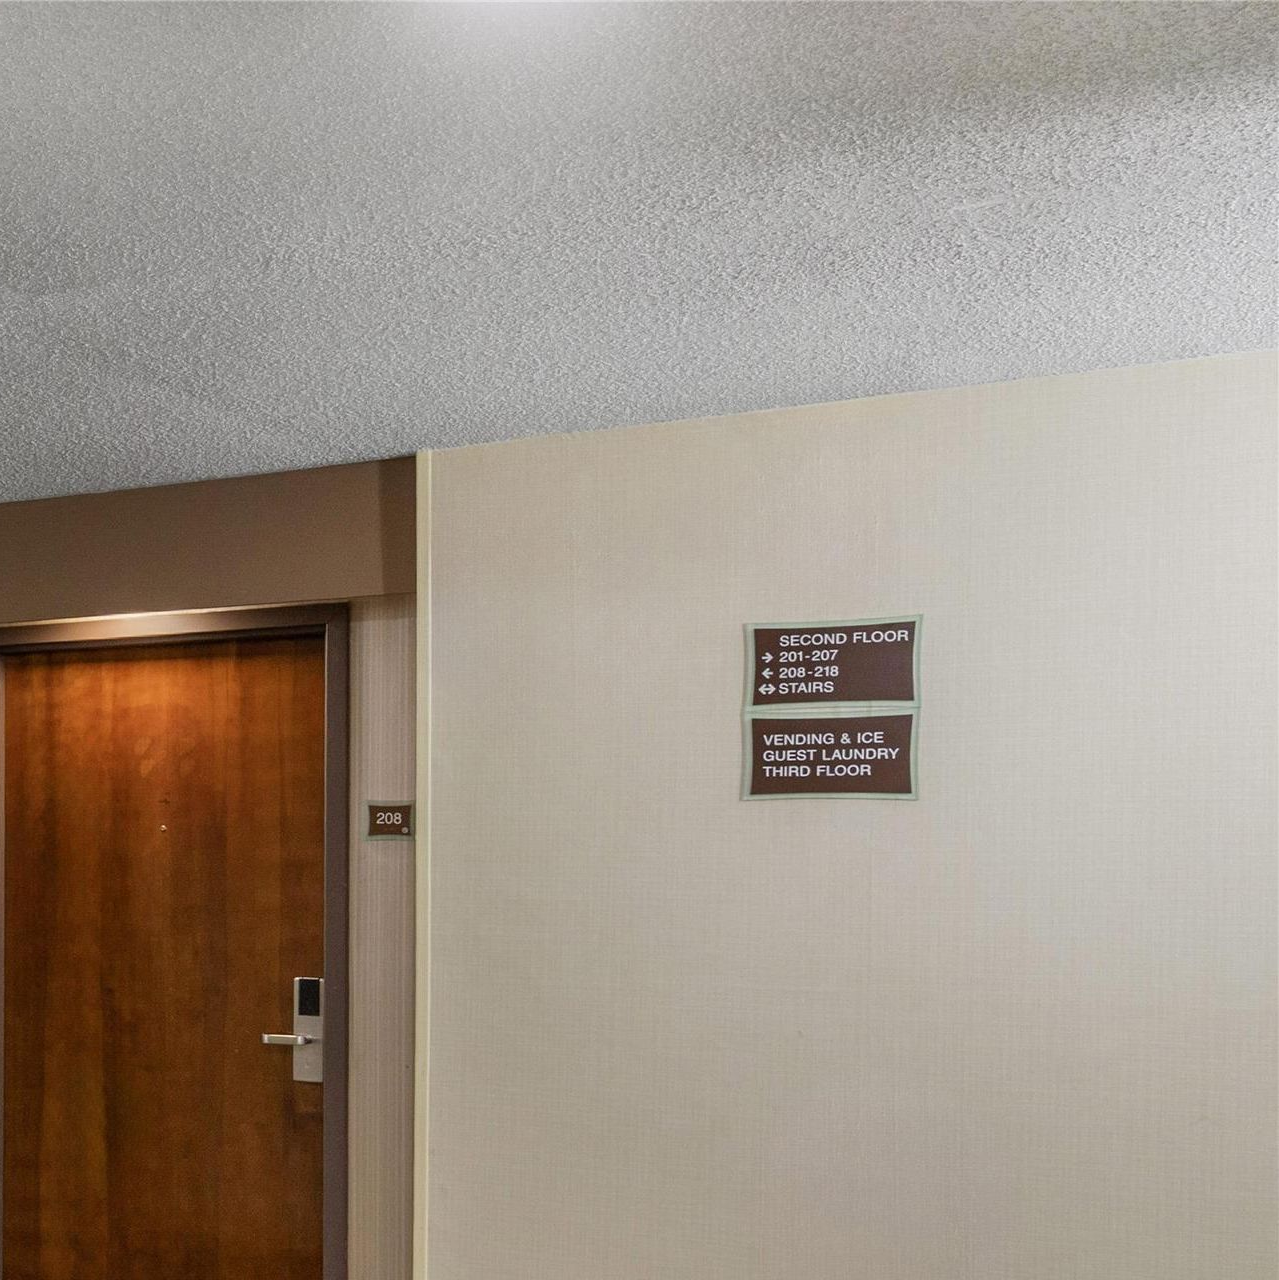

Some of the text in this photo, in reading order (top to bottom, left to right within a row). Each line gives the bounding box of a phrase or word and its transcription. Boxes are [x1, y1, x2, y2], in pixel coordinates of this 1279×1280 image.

[779, 630, 909, 648] SECOND FLOOR
[779, 649, 838, 663] 201-207
[779, 665, 839, 679] 208-218
[778, 681, 834, 695] STAIRS
[762, 731, 884, 746] VENDING & ICE
[762, 747, 899, 762] GUEST LAUNDRY
[763, 764, 872, 777] THIRD FLOOR
[376, 812, 402, 825] 208
